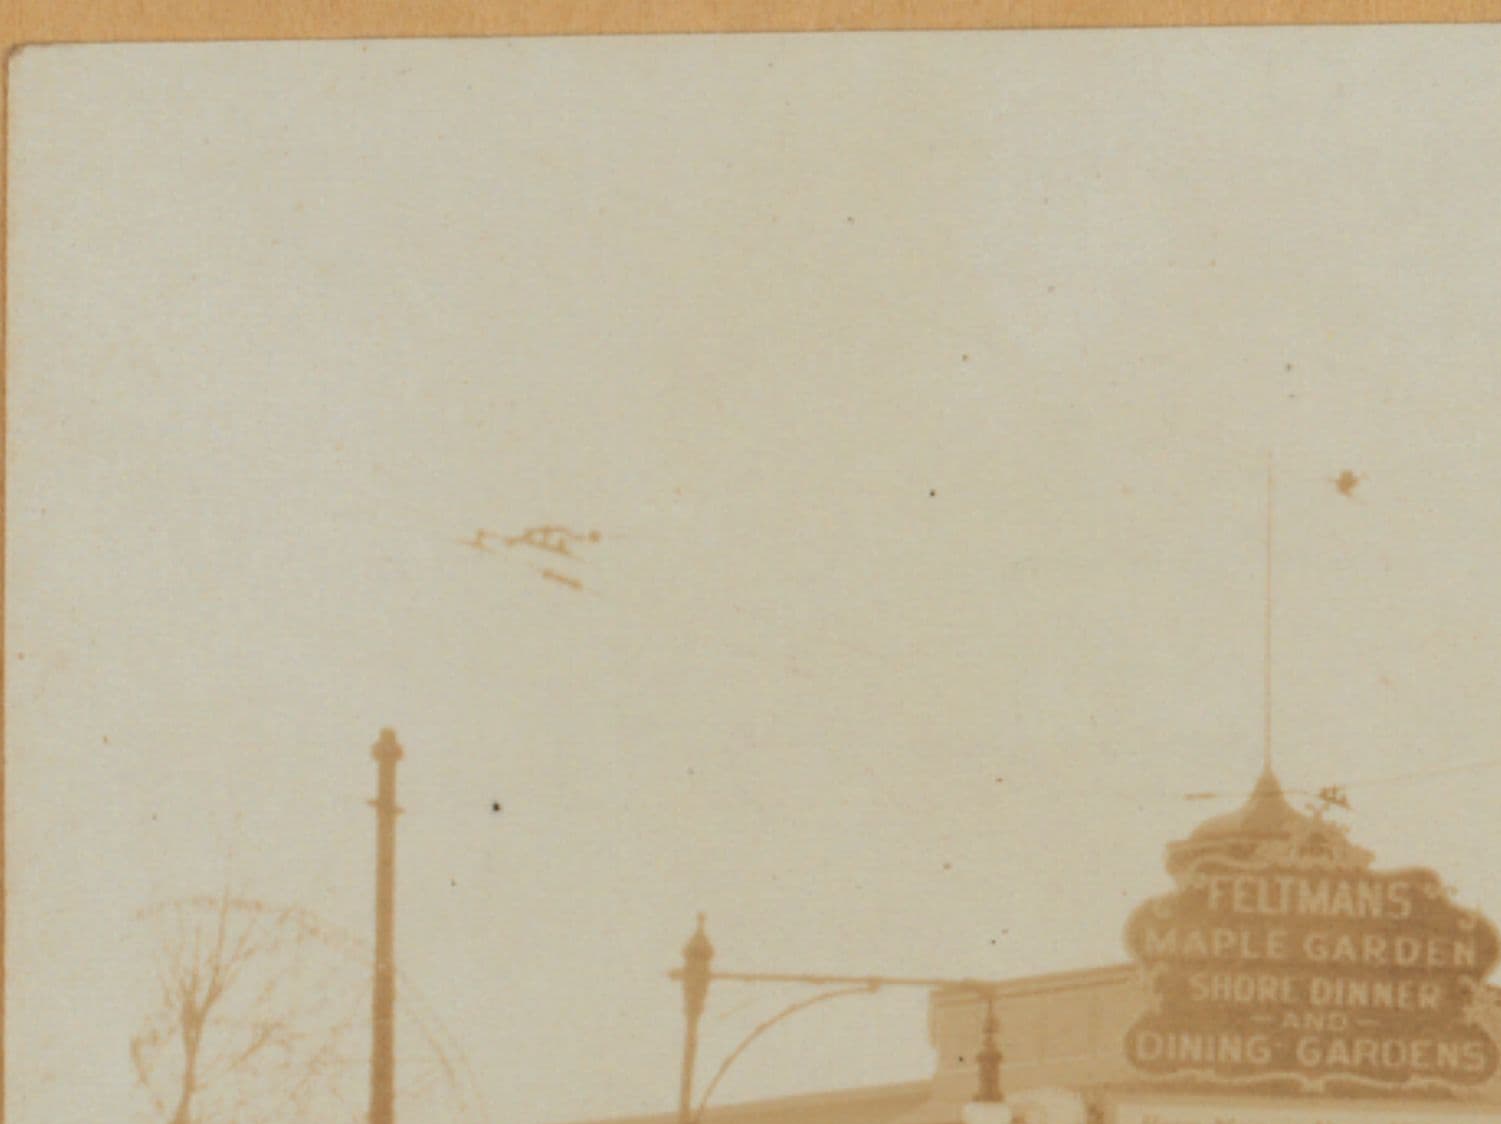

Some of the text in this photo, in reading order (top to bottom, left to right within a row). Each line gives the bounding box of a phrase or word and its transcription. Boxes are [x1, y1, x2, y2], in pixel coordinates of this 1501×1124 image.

[1206, 874, 1412, 920] FELTMANS
[1143, 926, 1476, 968] MAPLE GARDEN
[1188, 972, 1442, 1009] SHORE DINNER
[1281, 1012, 1348, 1032] AND
[1134, 1030, 1487, 1073] DINING GARDENS
